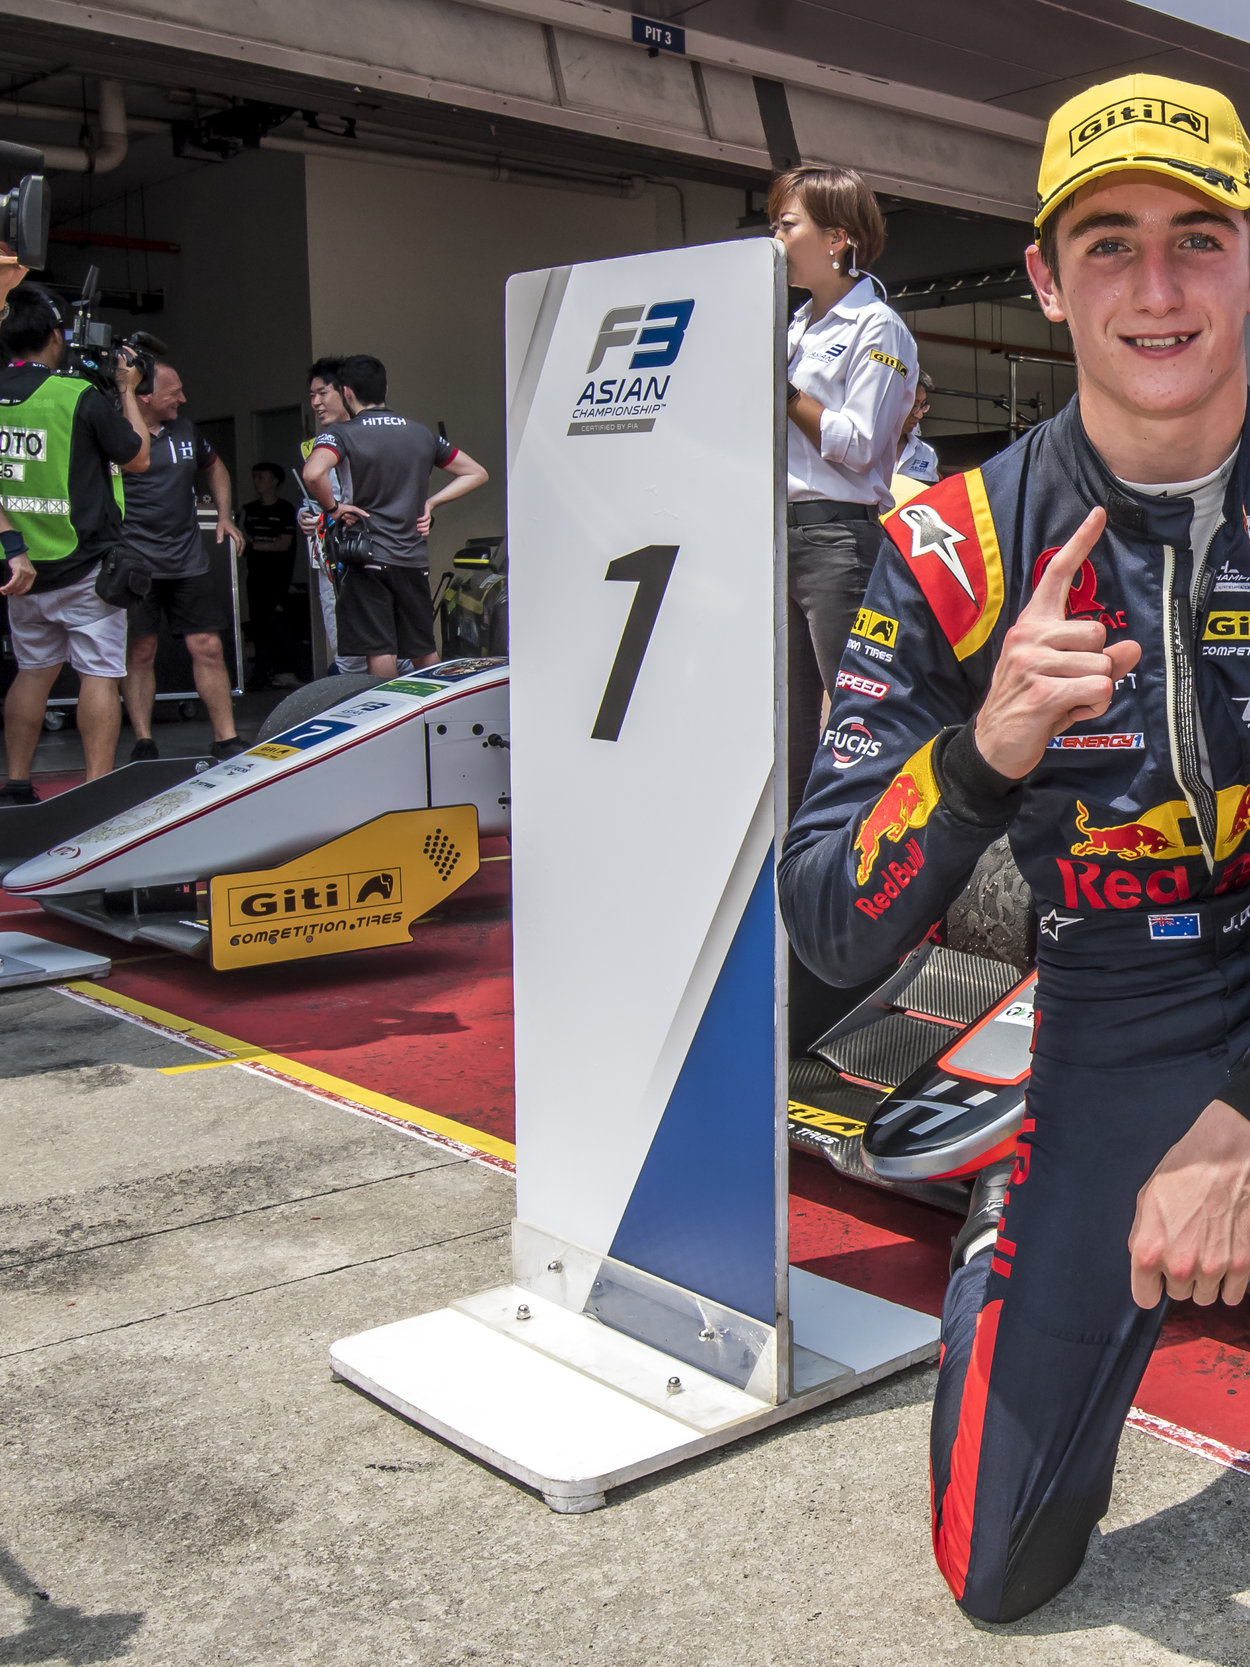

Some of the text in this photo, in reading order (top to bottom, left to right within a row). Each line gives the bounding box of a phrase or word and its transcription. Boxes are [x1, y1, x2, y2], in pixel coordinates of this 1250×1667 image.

[645, 25, 672, 45] PIT 3
[1078, 104, 1153, 142] Giti
[586, 298, 695, 374] F3
[576, 375, 671, 406] ASIAN
[362, 416, 407, 426] HITECH
[581, 422, 639, 432] CERTIFIED BY FIA
[590, 544, 680, 742] 1
[864, 645, 893, 662] TIRES
[291, 725, 333, 741] 7
[822, 730, 882, 757] FUCHS
[854, 837, 925, 920] Red Bull
[1056, 858, 1190, 909] Red
[240, 883, 339, 917] Giti
[230, 912, 403, 946] COMPETITION TIRES
[795, 1127, 840, 1144] TIRES
